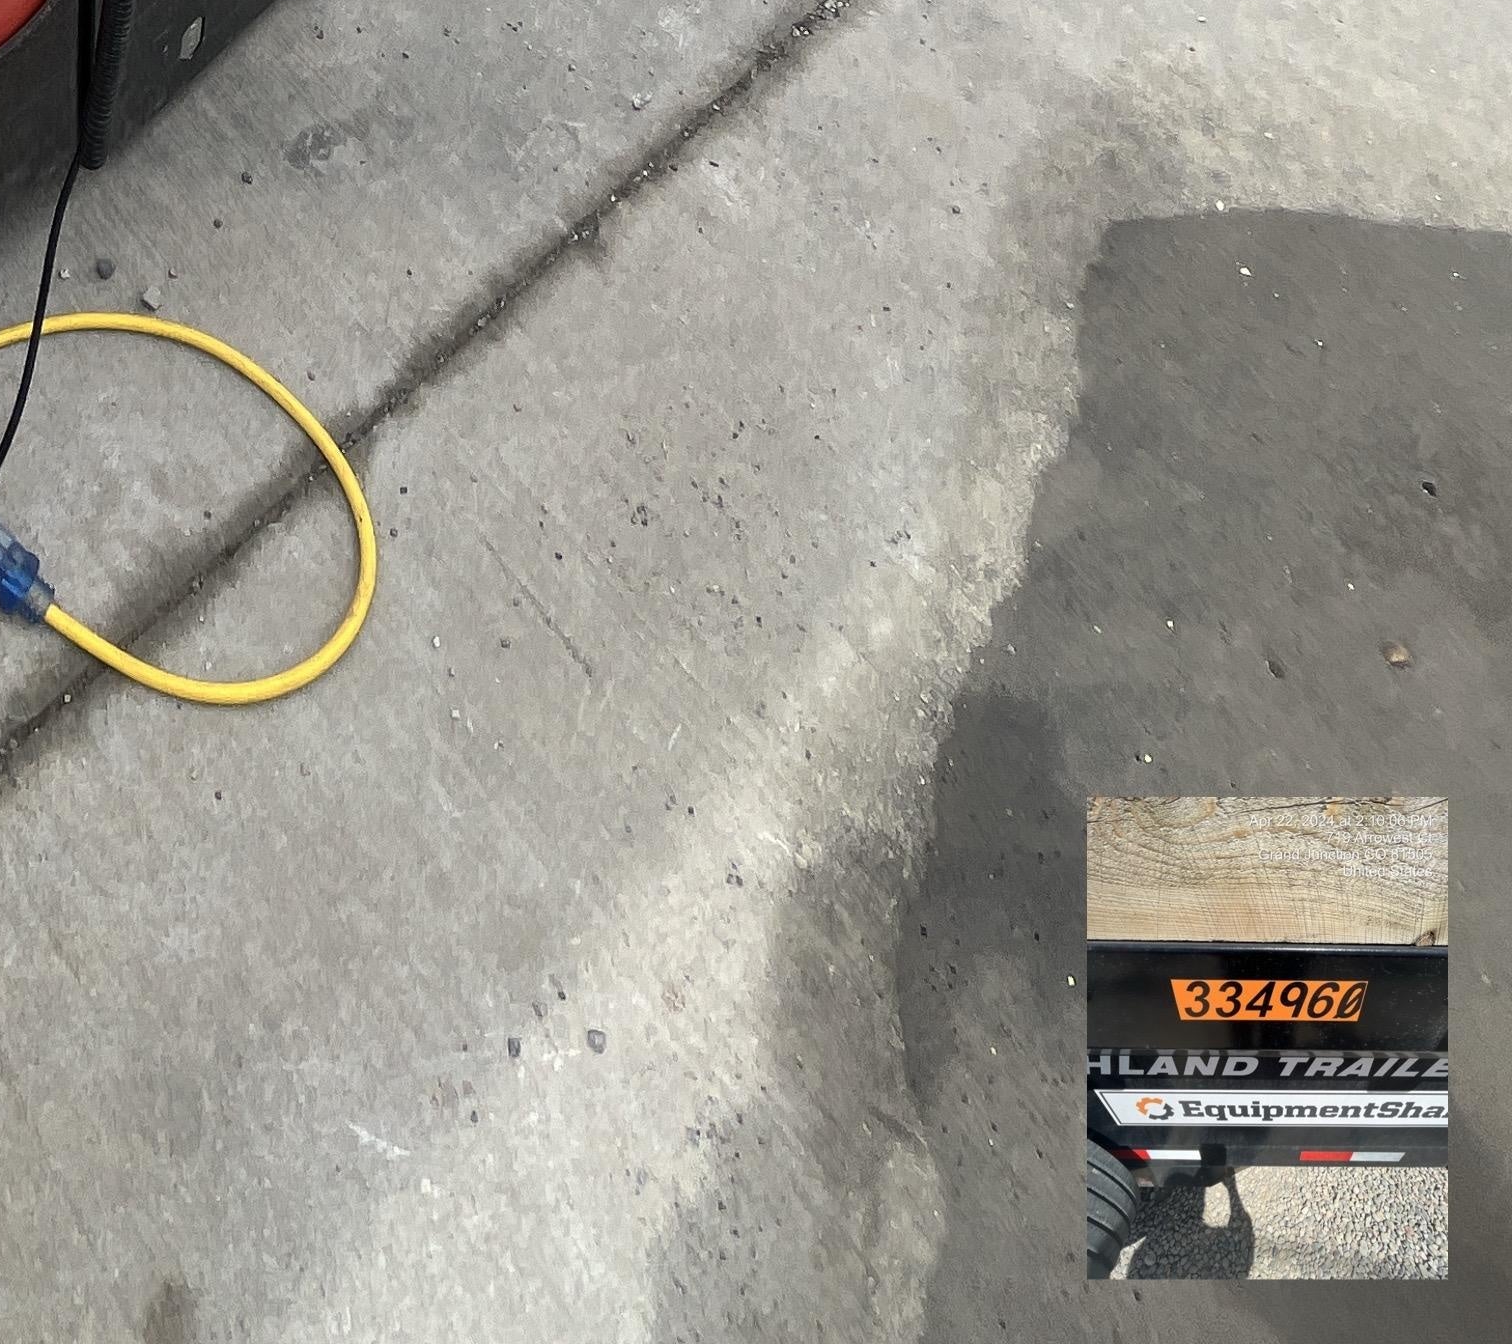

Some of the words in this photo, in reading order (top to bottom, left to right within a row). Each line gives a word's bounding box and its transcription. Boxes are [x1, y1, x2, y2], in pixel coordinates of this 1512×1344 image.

[1184, 981, 1365, 1019] 334960
[1088, 1055, 1259, 1076] HLAND
[1178, 1100, 1448, 1123] EquipmentSha
